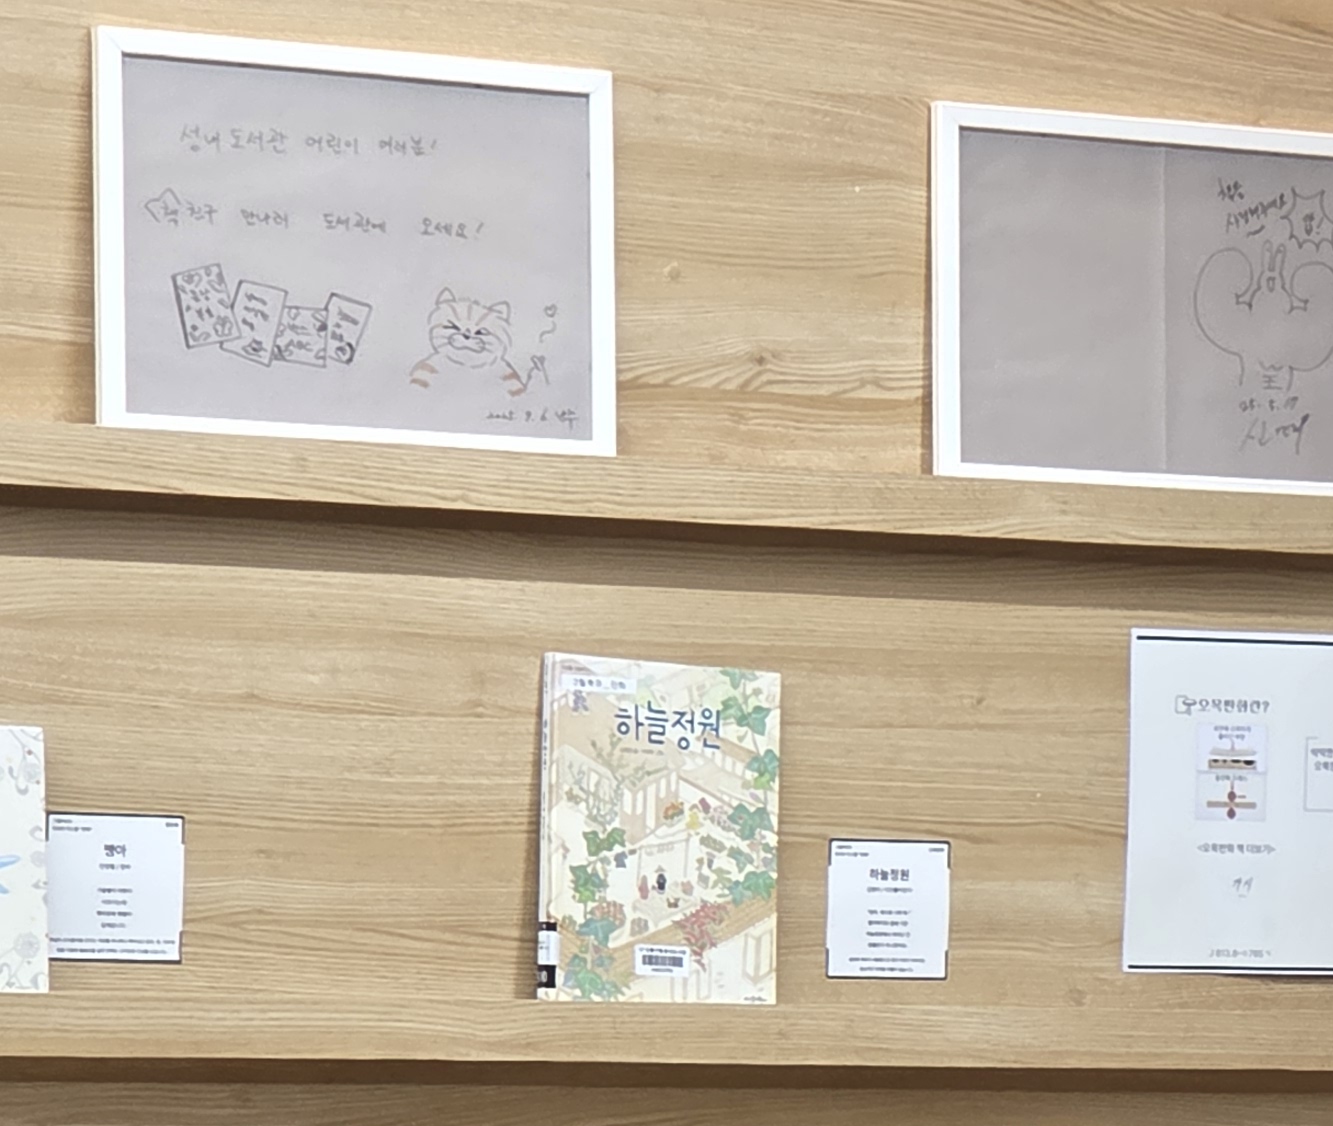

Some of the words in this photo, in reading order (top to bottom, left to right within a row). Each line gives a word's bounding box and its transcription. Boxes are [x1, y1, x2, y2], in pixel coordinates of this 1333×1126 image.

[305, 133, 358, 154] 어린이
[240, 208, 289, 228] 만나러
[323, 212, 387, 233] 도서관에
[421, 218, 485, 239] 오세요!
[614, 700, 722, 750] 하늘정원
[869, 868, 910, 881] 하늘정원
